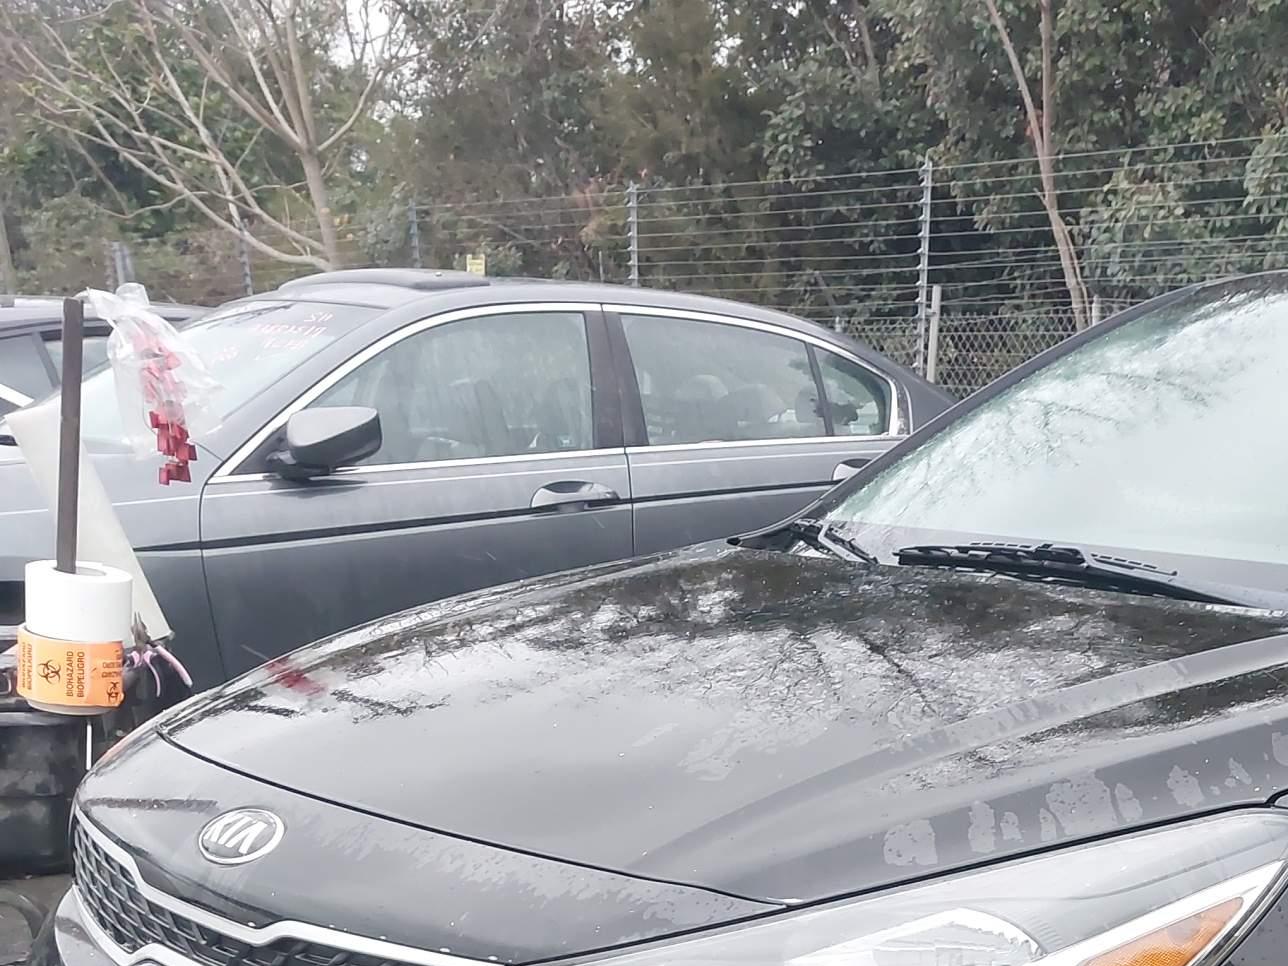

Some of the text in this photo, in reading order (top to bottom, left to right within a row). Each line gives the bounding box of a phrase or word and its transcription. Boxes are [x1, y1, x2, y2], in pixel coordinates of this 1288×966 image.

[66, 650, 74, 697] BIOHAZARD
[77, 651, 86, 698] BIOPELIGRO
[202, 812, 270, 855] KIA
